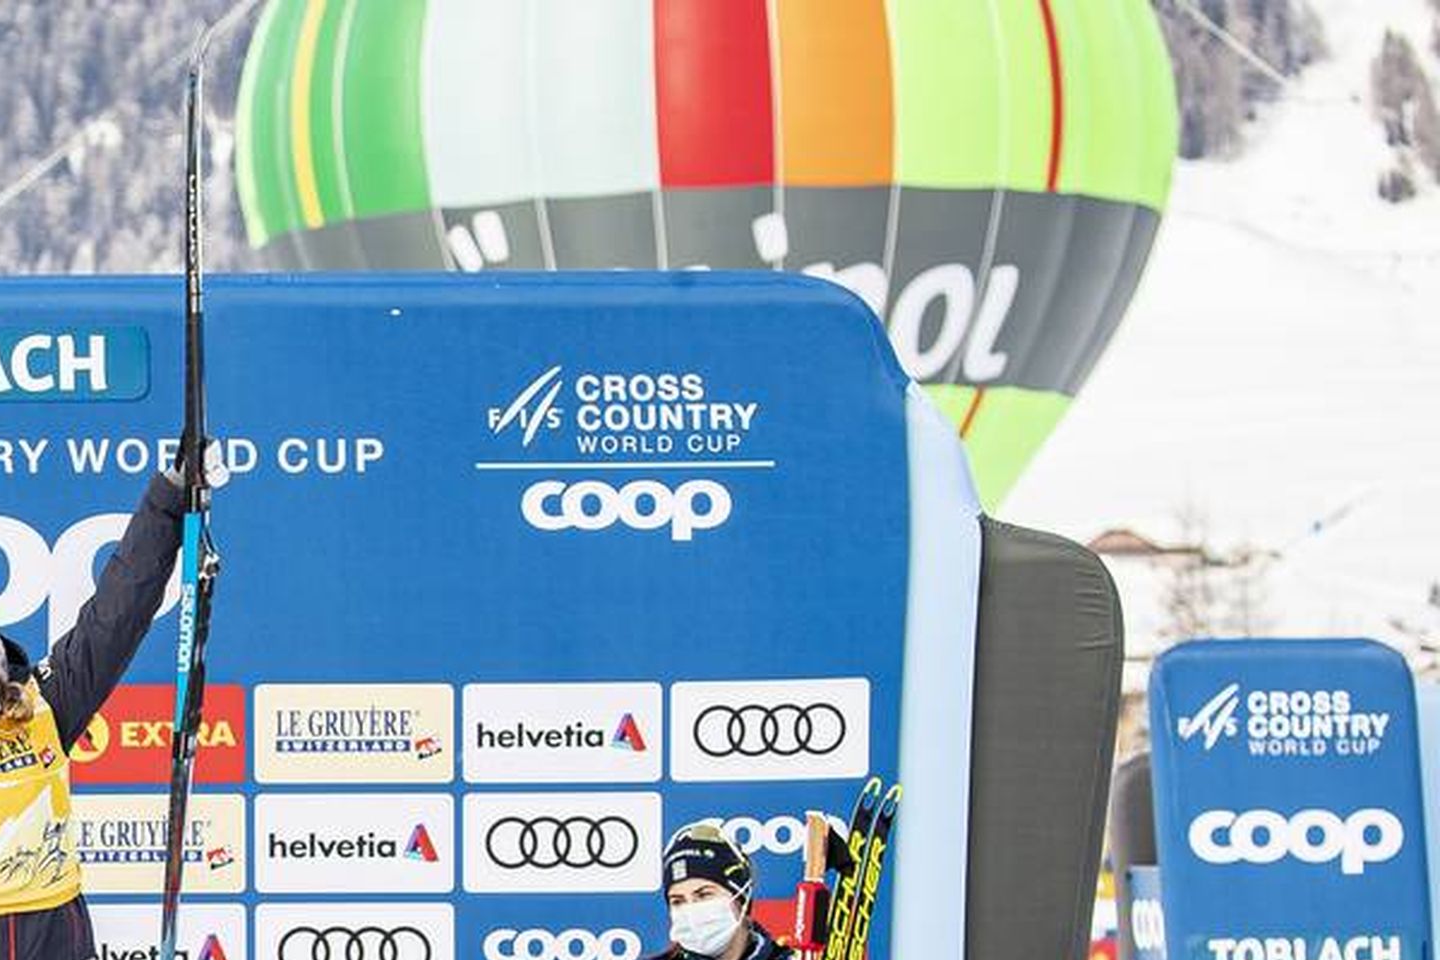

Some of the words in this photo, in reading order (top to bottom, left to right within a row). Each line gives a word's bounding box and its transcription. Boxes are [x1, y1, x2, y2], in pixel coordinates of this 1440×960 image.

[575, 374, 705, 402] CROSS
[575, 402, 758, 431] COUNTRY
[68, 437, 259, 475] WORD
[276, 436, 385, 473] CUP
[576, 435, 675, 455] WORLD
[687, 434, 742, 453] CUP
[520, 480, 733, 541] coop
[1247, 690, 1351, 715] CROSS
[275, 709, 304, 737] LE
[309, 702, 413, 736] GRUYÈRE
[1247, 713, 1389, 738] COUNTRY
[120, 721, 236, 749] EXRA
[476, 723, 605, 750] helvetia
[1248, 739, 1327, 756] WORLD
[1336, 738, 1381, 755] CUP
[268, 833, 397, 859] helvetia
[1188, 808, 1404, 875] coop
